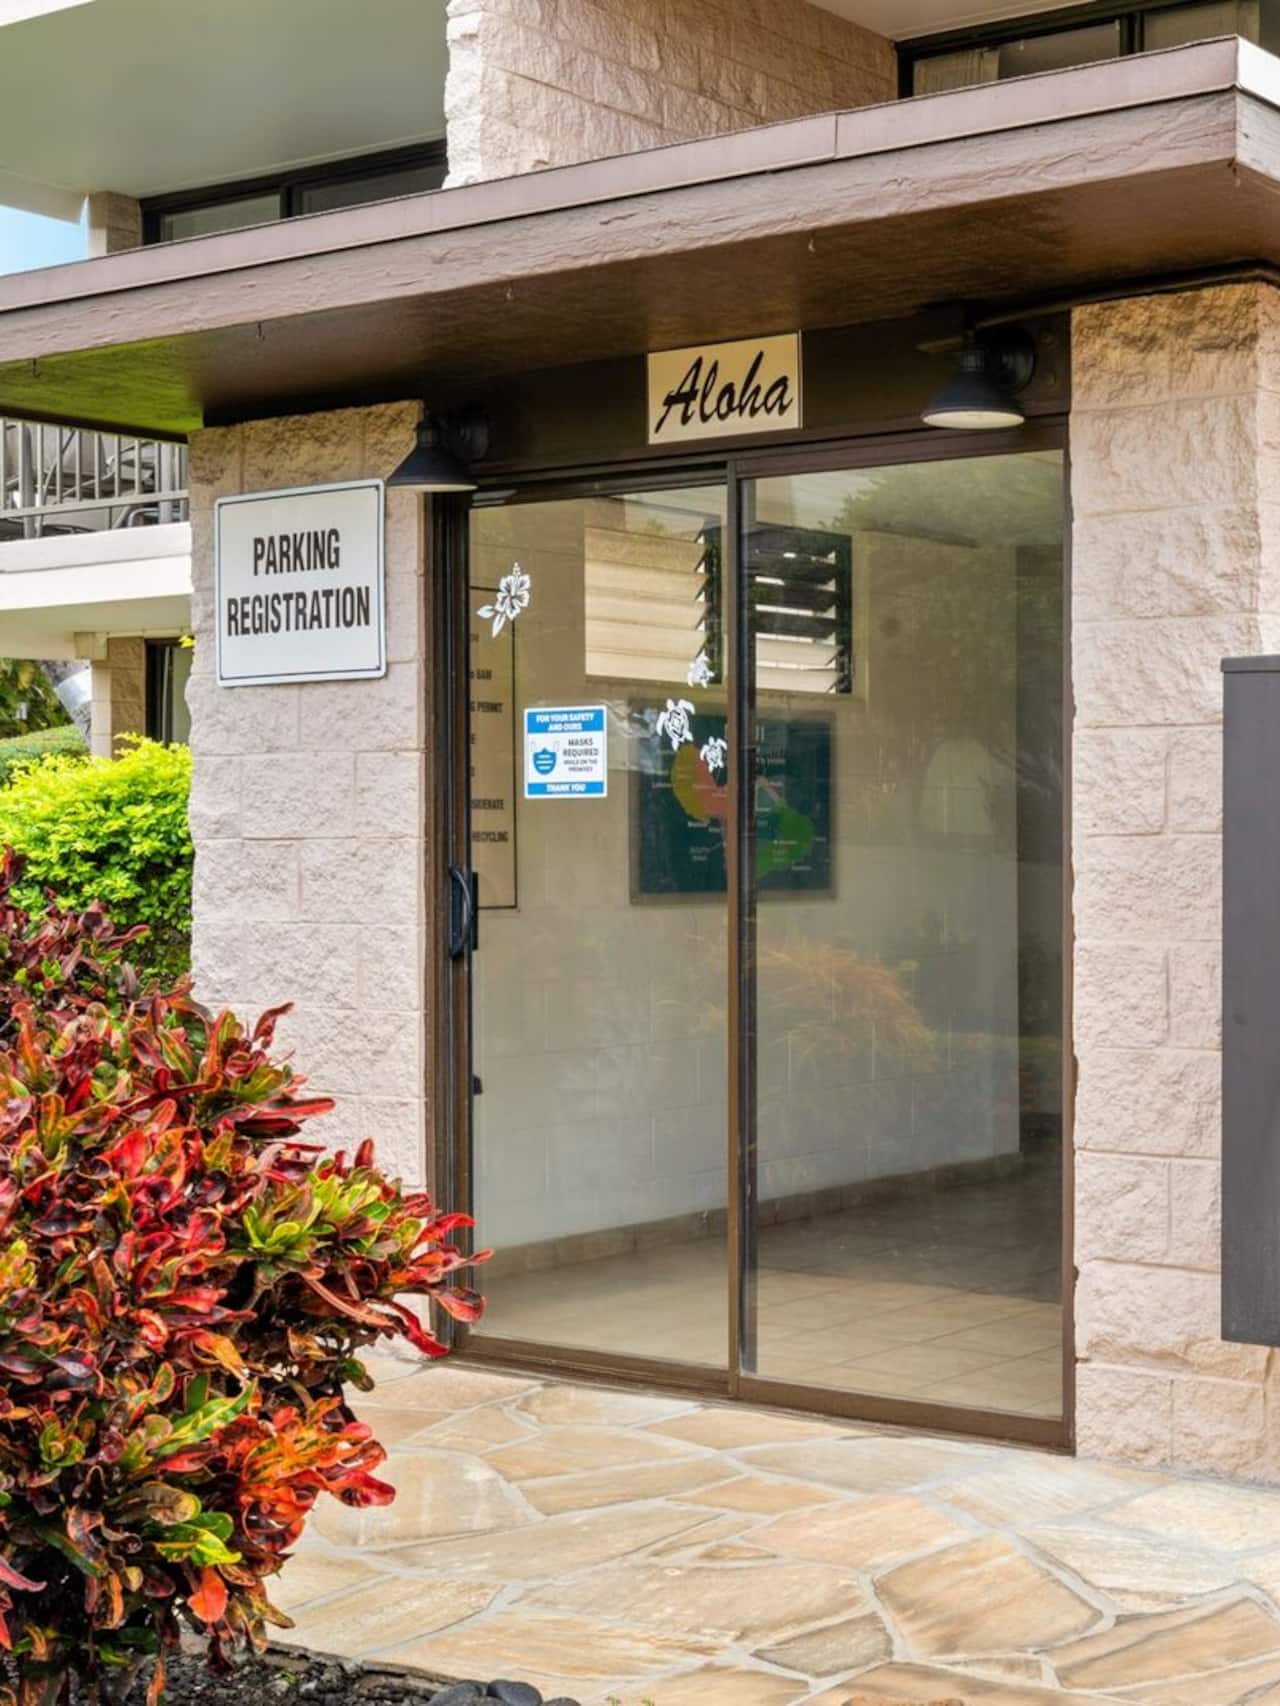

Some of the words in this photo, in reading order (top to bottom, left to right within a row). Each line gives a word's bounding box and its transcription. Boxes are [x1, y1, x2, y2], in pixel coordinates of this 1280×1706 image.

[654, 350, 793, 434] Aloha
[253, 528, 340, 576] PARKING
[227, 586, 370, 636] REGISTRATION
[569, 712, 595, 721] SAFETY
[568, 738, 593, 746] MASKS
[562, 748, 599, 757] REQUIRED
[546, 784, 569, 793] THANK
[571, 783, 586, 792] YOU
